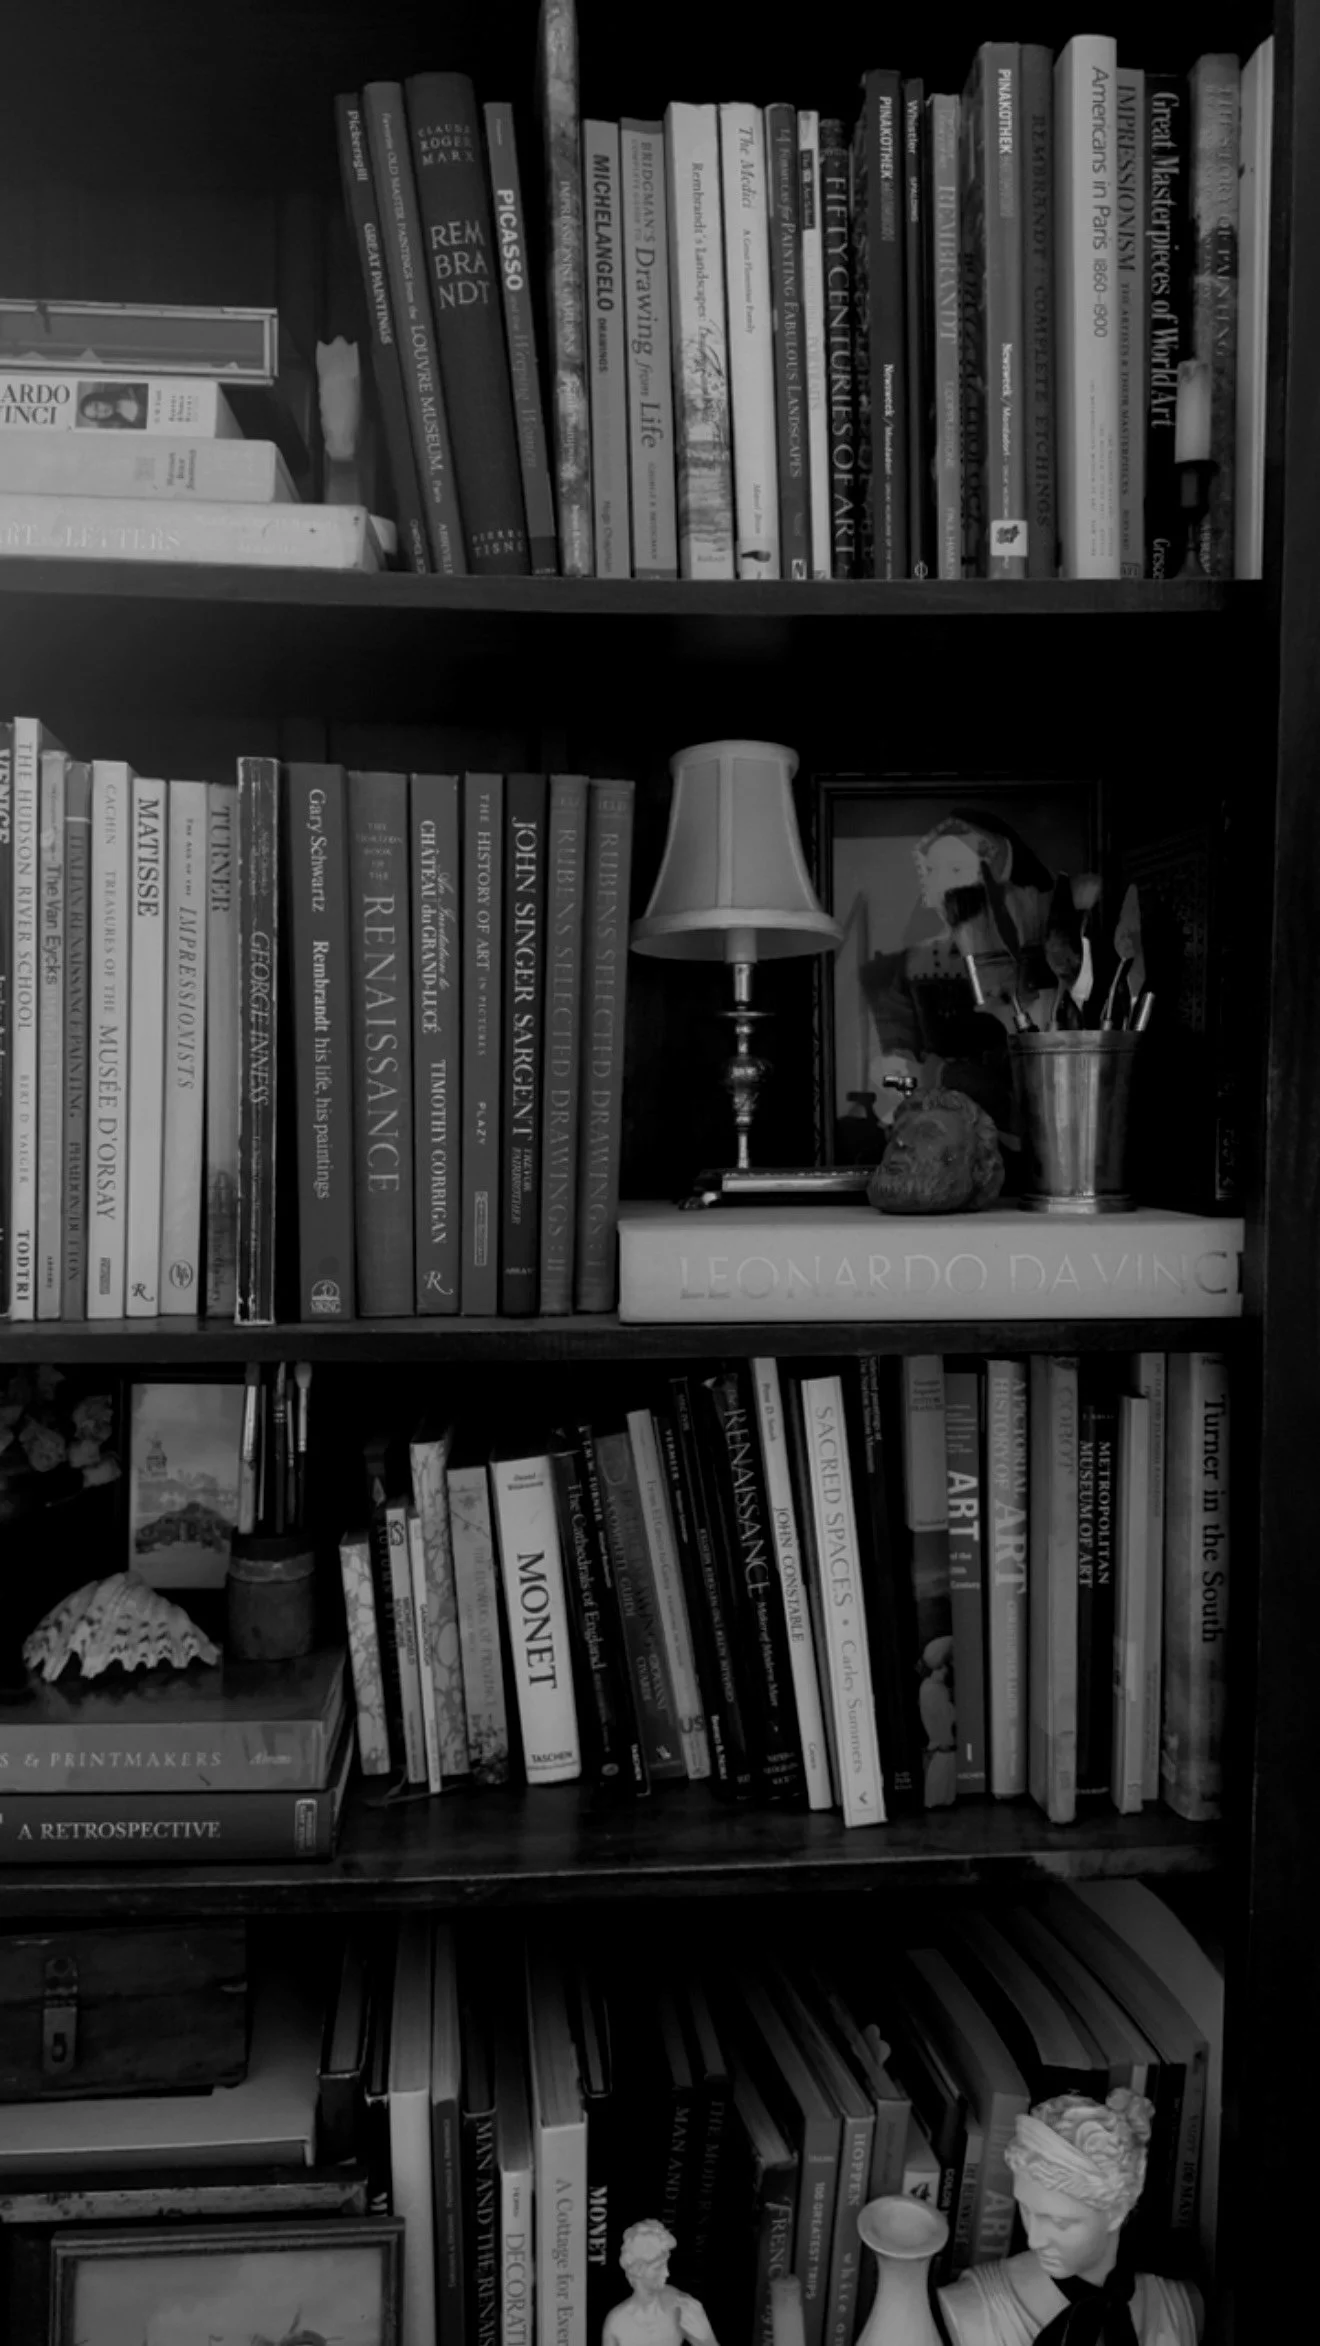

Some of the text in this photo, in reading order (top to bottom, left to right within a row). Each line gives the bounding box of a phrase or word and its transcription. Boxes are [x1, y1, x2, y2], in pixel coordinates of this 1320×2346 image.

[879, 96, 894, 180] PINAKOTHEK
[906, 100, 919, 155] Whistler
[997, 68, 1013, 155] PINAKOTHEK
[386, 151, 400, 176] OLD
[390, 176, 407, 220] MASTER
[421, 149, 475, 167] MARX
[738, 126, 758, 210] The Medici
[1090, 66, 1112, 251] Americans in Paris
[1116, 85, 1137, 273] IMPRESSIONISM
[363, 222, 382, 268] GREAT
[429, 219, 487, 251] REM
[592, 154, 615, 312] MICHELANGELO
[690, 161, 708, 245] Rembrandt's
[396, 221, 415, 280] PAINTINGS
[433, 250, 489, 280] BRA
[936, 184, 957, 345] REMBRANDT
[1144, 91, 1181, 428] Great Masterpieces of World Art
[370, 269, 392, 346] PAINTINGS
[438, 280, 490, 311] NDT
[495, 187, 538, 470] PICASSO Weeping Women
[631, 141, 665, 449] BRIDGMAN'S Drawing Life
[776, 148, 805, 478] FORMULAS for PAINTING FABULOUS LANDSCAPES
[1030, 113, 1051, 528] REMBRANDT COMPLETE ETCHINGS
[409, 324, 432, 393] LOUVRE
[597, 316, 609, 376] DRAWINGS
[824, 176, 857, 562] FIFTY CENTURIES OF ART
[0, 384, 71, 404] ARDO
[43, 863, 63, 898] The
[68, 834, 86, 911] ITALIAN
[136, 797, 161, 918] MATISSE
[209, 805, 233, 914] TURNER
[43, 899, 62, 930] Van
[419, 819, 443, 1035] CHÂTEAU du GRAND-LUCÉ
[40, 934, 62, 986] Eycks
[96, 784, 121, 1221] CACHIN TREASURES OF THE MUSÉE D'ORSAY
[175, 905, 198, 1090] IMPRESSIONISTS
[249, 930, 273, 1025] GEORGE
[304, 788, 334, 1200] Gary Schwartz Rembrandt his life, his paintings
[474, 793, 492, 1147] THE HISTORY OF ART IN PICTURES PLAZY
[510, 815, 538, 1143] JOHN SINGER SARGENT
[16, 742, 34, 1302] THE HUDSON RIVER SCHOOL TODTRI
[361, 893, 401, 1194] RENAISSANCE
[548, 827, 581, 1238] RUBENS SELECTED DRAWINGS
[589, 831, 620, 1236] RUBENS SELECTED DRAWINGS
[249, 1028, 273, 1107] INNESS
[428, 1058, 448, 1245] TIMOTHY CORRIGAN
[678, 1252, 990, 1299] LEONARDO
[1008, 1252, 1083, 1294] DA
[664, 1428, 680, 1481] VERMEER
[993, 1376, 1010, 1491] HISTORY OF
[1056, 1385, 1075, 1475] COROT
[1201, 1394, 1226, 1480] Turner
[722, 1408, 771, 1599] RENAISSANCE
[946, 1470, 980, 1542] ART
[1077, 1440, 1094, 1588] MUSEUM OF ART
[1095, 1440, 1112, 1586] METROPOLITAN
[1202, 1524, 1226, 1562] the
[1203, 1489, 1225, 1513] in
[567, 1482, 608, 1671] The Cathedrals of England
[774, 1507, 805, 1643] JOHN CONSTABLE
[814, 1405, 868, 1775] SACRED SPACES Carley Summers
[994, 1499, 1027, 1596] ART
[515, 1551, 558, 1691] MONET
[1201, 1570, 1225, 1644] South
[49, 1751, 223, 1768] PRINTMAKERS
[531, 1751, 574, 1764] TASCHEN
[40, 1819, 222, 1841] RETROSPECTIVE
[664, 2105, 691, 2201] MAN AND
[706, 2099, 726, 2137] THE
[474, 2120, 495, 2273] MAN AND THE
[587, 2184, 609, 2268] MONET
[834, 2133, 867, 2313] HOPPEN white
[941, 2167, 956, 2209] COLOR
[978, 2188, 1013, 2260] ART
[552, 2197, 576, 2271] Cottage
[804, 2181, 826, 2300] 100 GREATEST TRIPS
[556, 2272, 576, 2301] for
